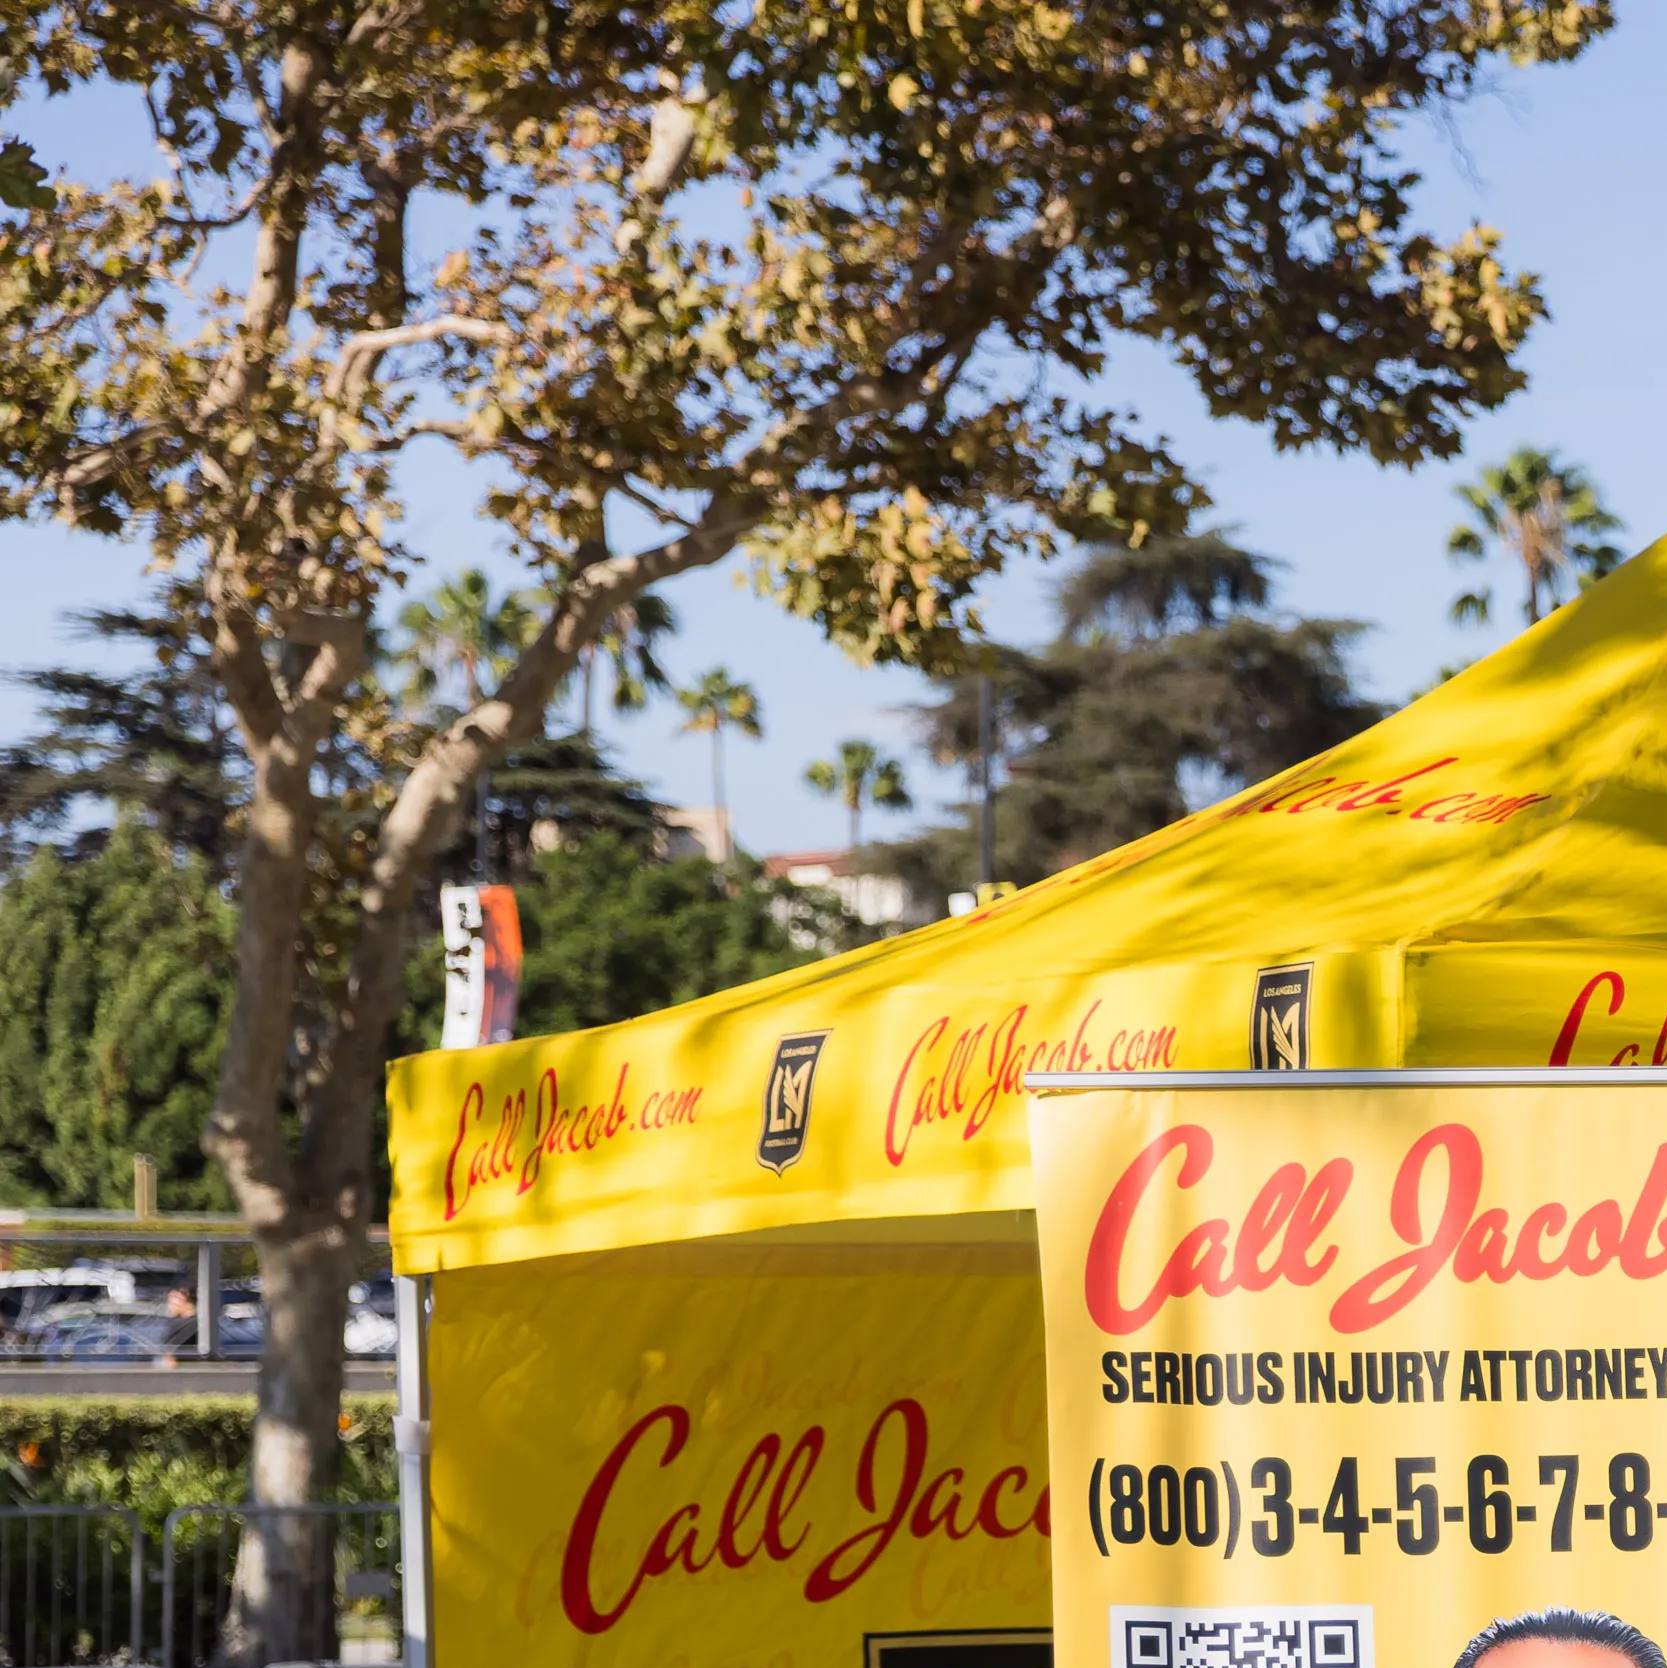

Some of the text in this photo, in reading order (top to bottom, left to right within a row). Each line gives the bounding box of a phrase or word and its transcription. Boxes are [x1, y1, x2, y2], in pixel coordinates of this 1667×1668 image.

[444, 1080, 530, 1222] Call
[884, 1014, 990, 1168] Call
[1084, 1123, 1355, 1336] Call
[1101, 1350, 1284, 1407] SERIOUS
[1294, 1350, 1450, 1405] INJURY
[560, 1403, 826, 1635] Call
